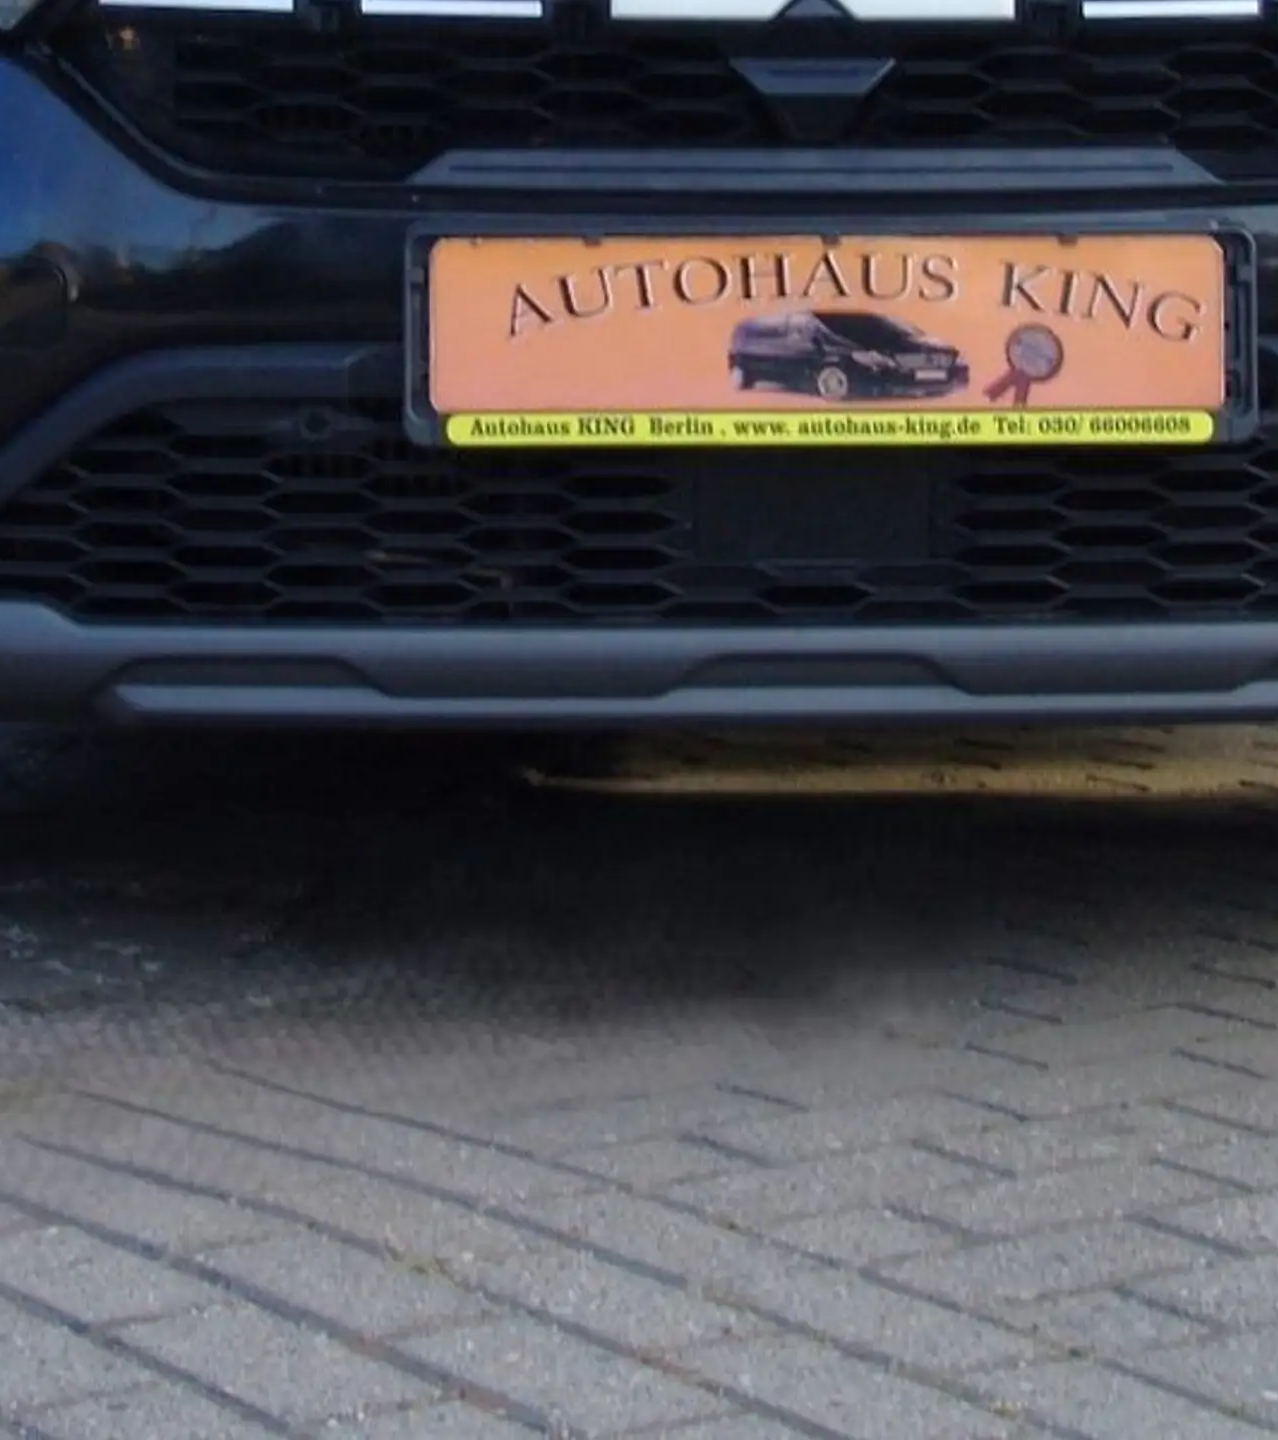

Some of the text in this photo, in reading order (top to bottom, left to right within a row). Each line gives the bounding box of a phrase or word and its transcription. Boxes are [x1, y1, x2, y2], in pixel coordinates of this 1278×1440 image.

[507, 250, 1207, 344] AUTOHAUS KING
[470, 416, 571, 437] Autohaus
[577, 416, 635, 437] KING
